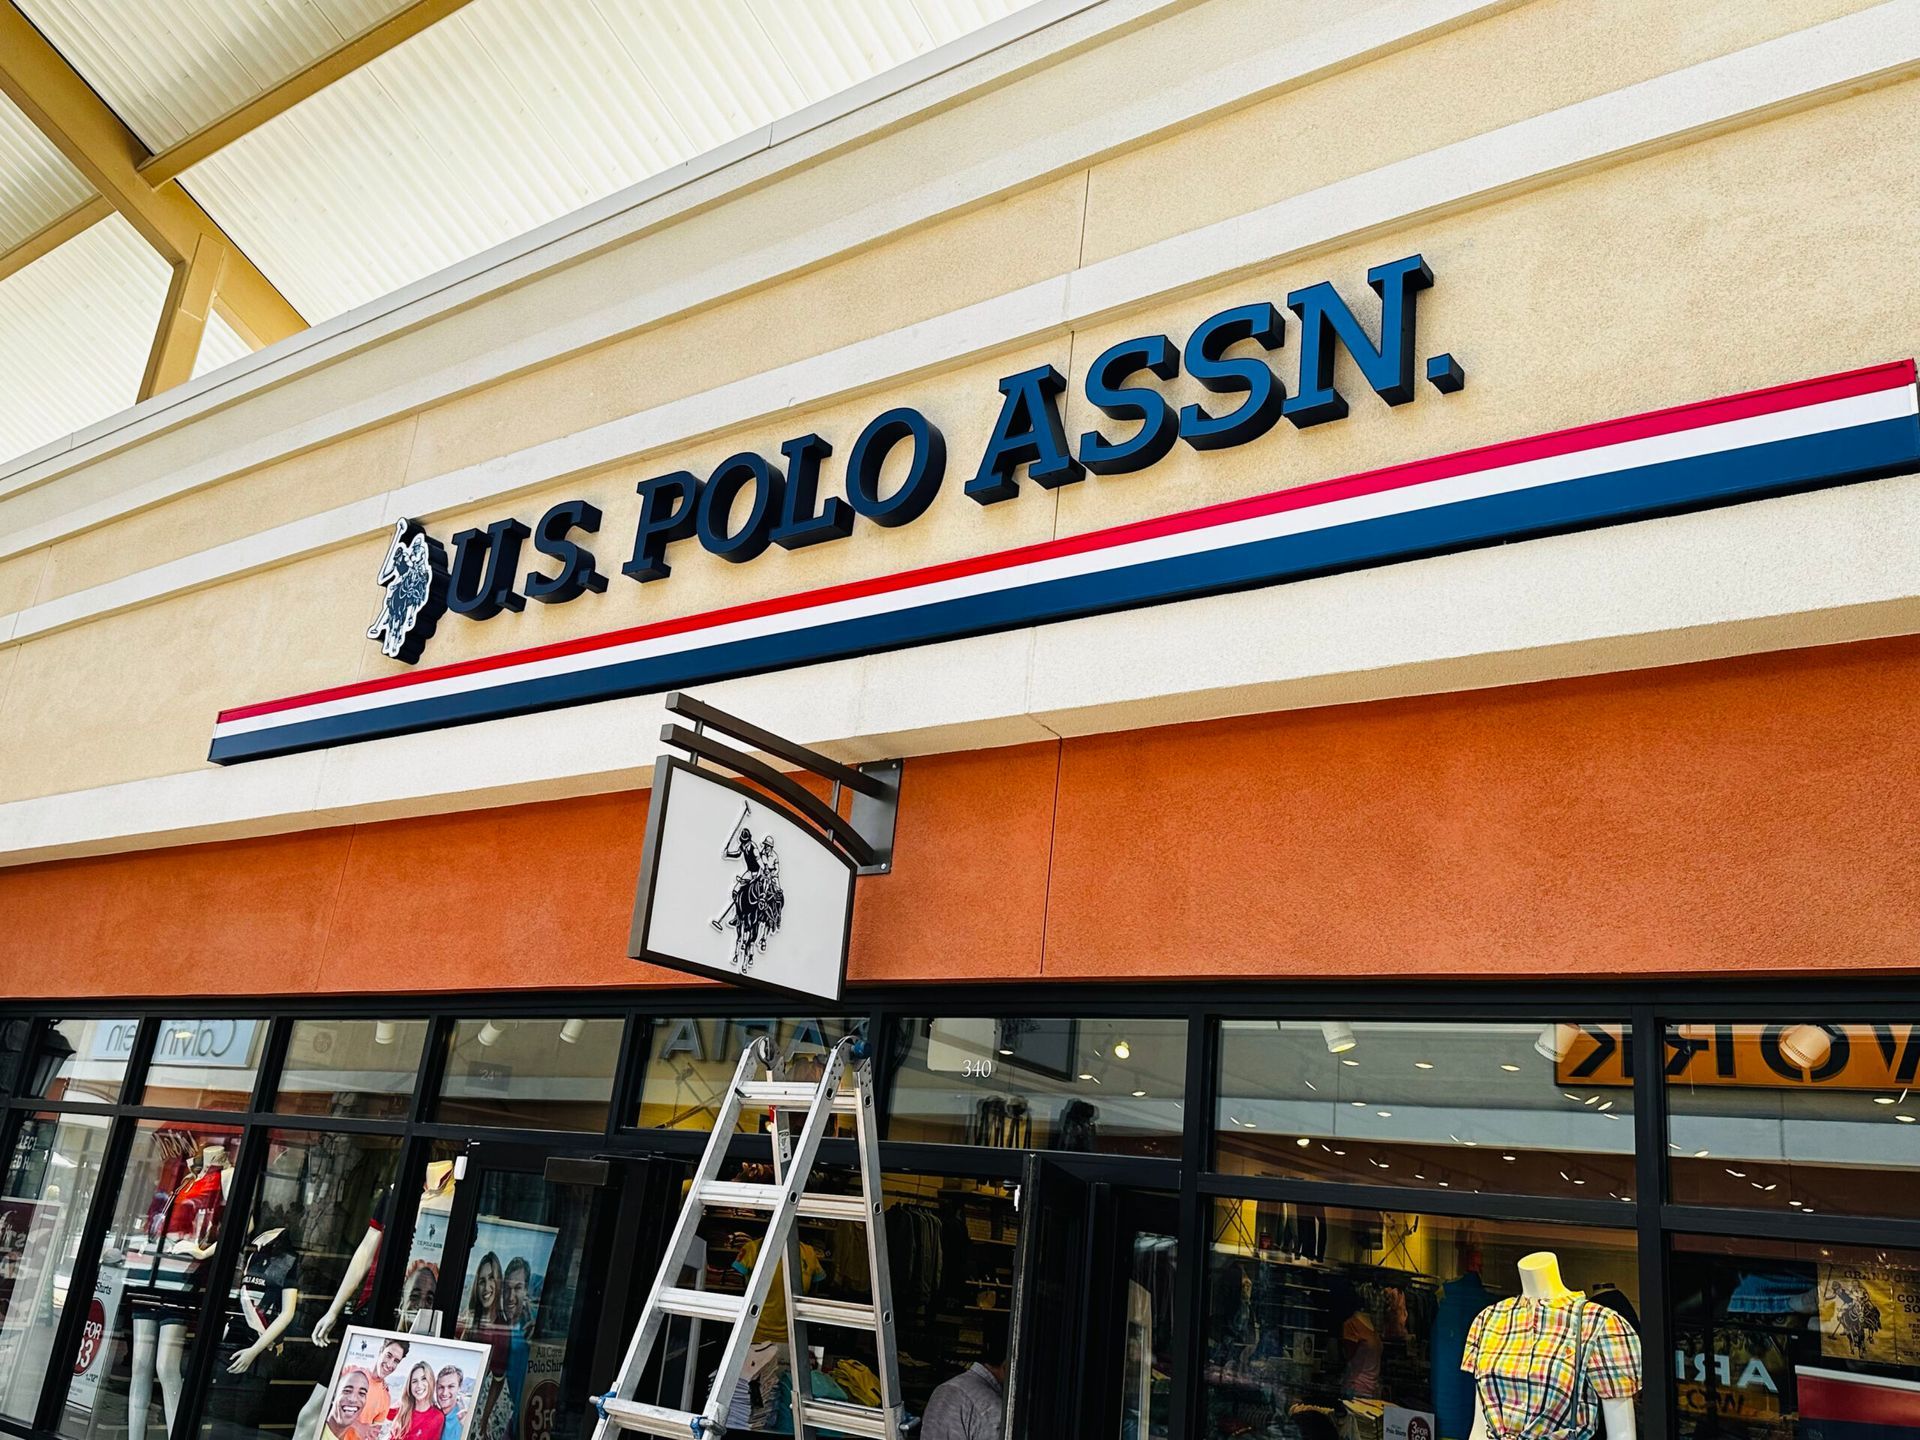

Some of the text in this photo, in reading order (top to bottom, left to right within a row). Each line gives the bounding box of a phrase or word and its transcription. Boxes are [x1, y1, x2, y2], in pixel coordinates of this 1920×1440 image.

[447, 254, 1465, 622] U.S. POLO ASSN.
[962, 1059, 993, 1078] 340
[83, 1319, 102, 1341] FOR
[528, 1361, 545, 1373] Polo
